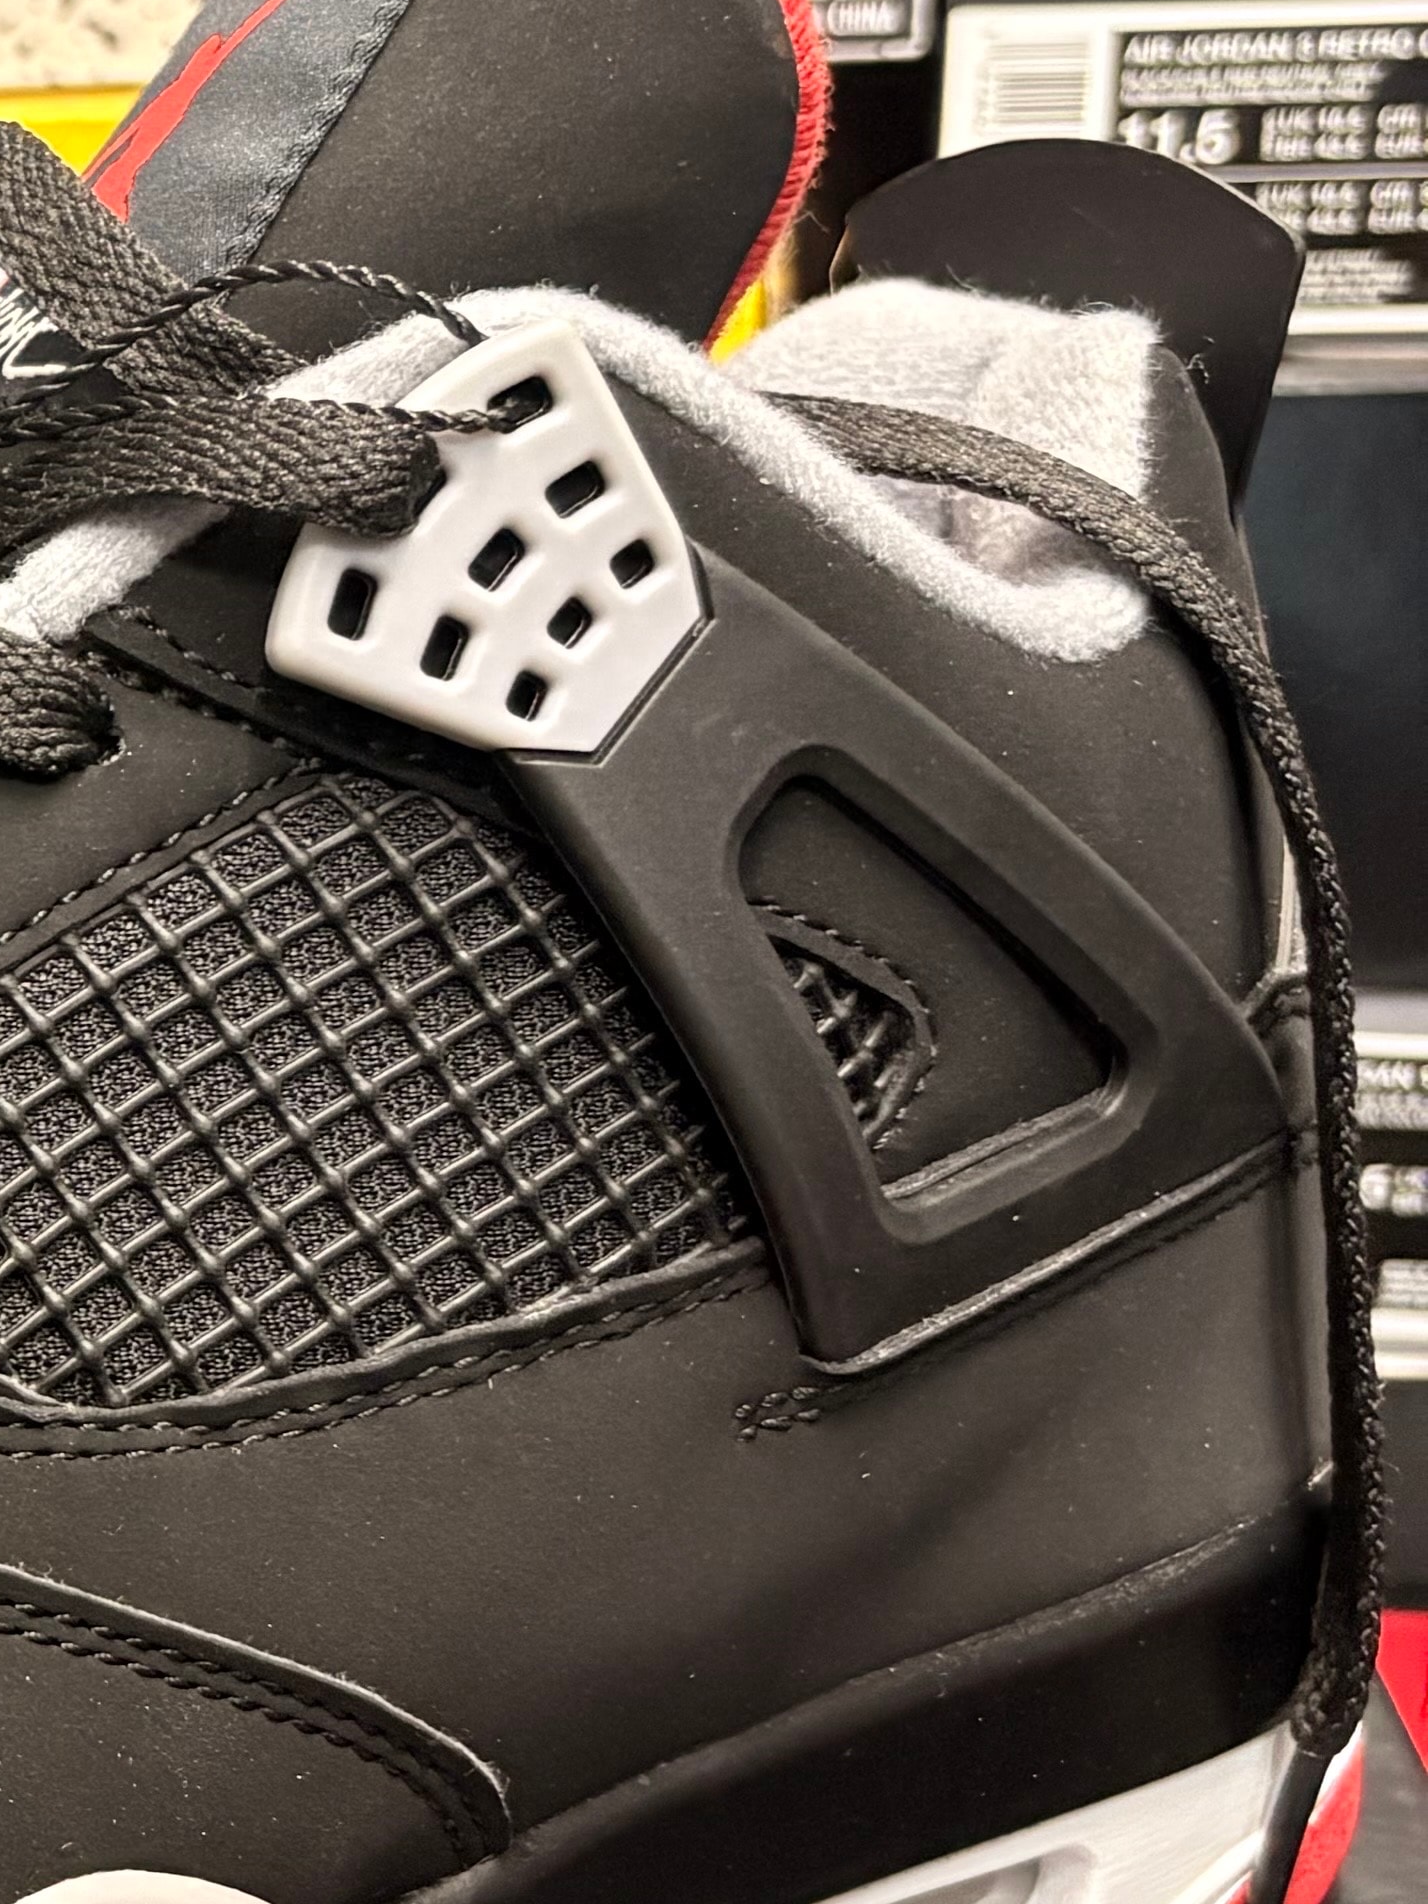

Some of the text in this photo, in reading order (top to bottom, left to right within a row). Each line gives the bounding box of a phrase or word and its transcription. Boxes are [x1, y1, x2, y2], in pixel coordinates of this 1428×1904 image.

[826, 0, 902, 37] CHINA
[1123, 31, 1175, 67] AIR
[1176, 29, 1294, 66] JORDAN
[1318, 26, 1416, 63] RETRO
[1118, 108, 1241, 165] 11.5
